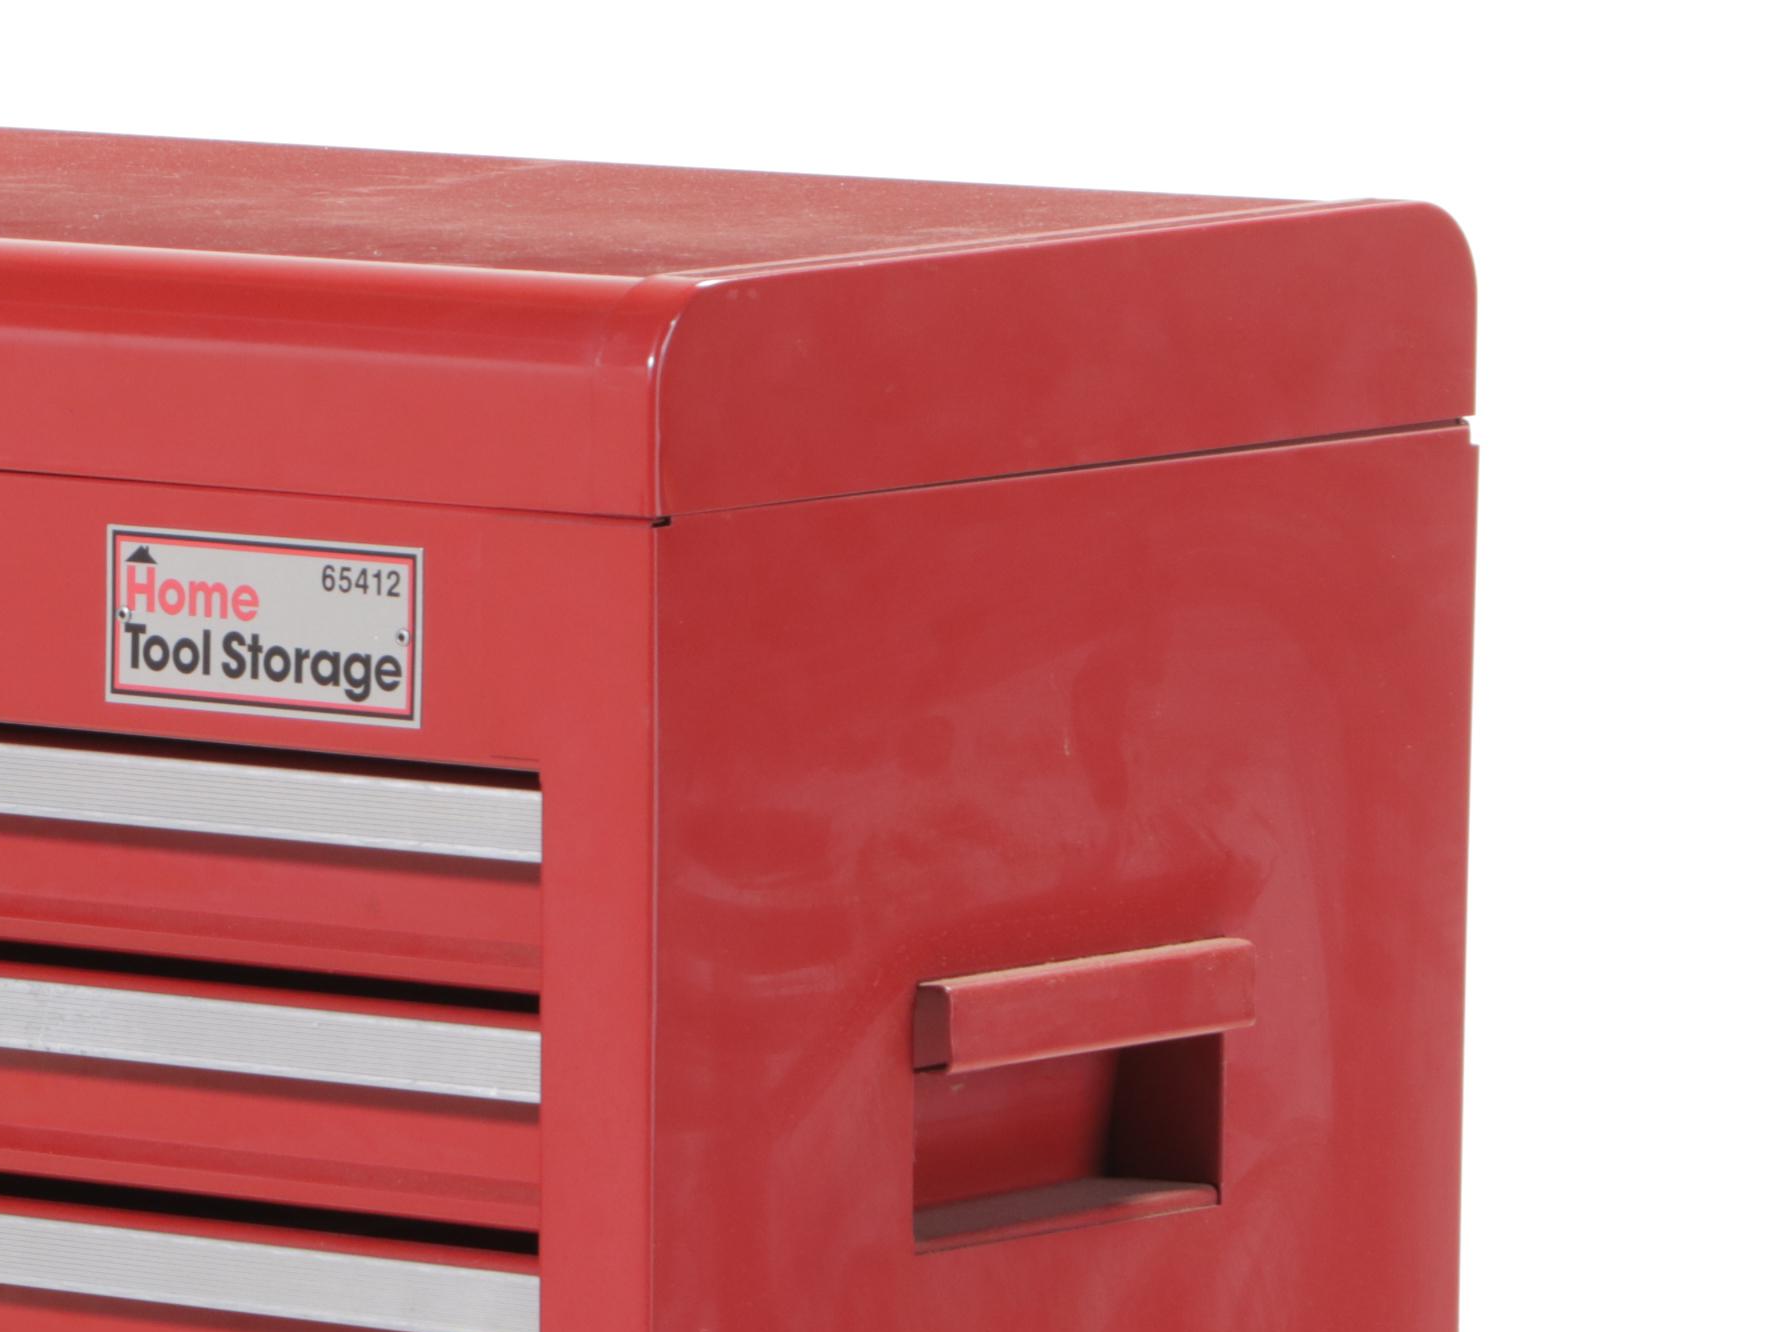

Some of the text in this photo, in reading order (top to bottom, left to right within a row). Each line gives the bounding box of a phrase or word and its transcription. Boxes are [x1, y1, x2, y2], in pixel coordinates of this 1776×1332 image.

[126, 564, 260, 622] Home
[321, 564, 401, 597] 65412
[124, 622, 402, 702] Tool Storage
